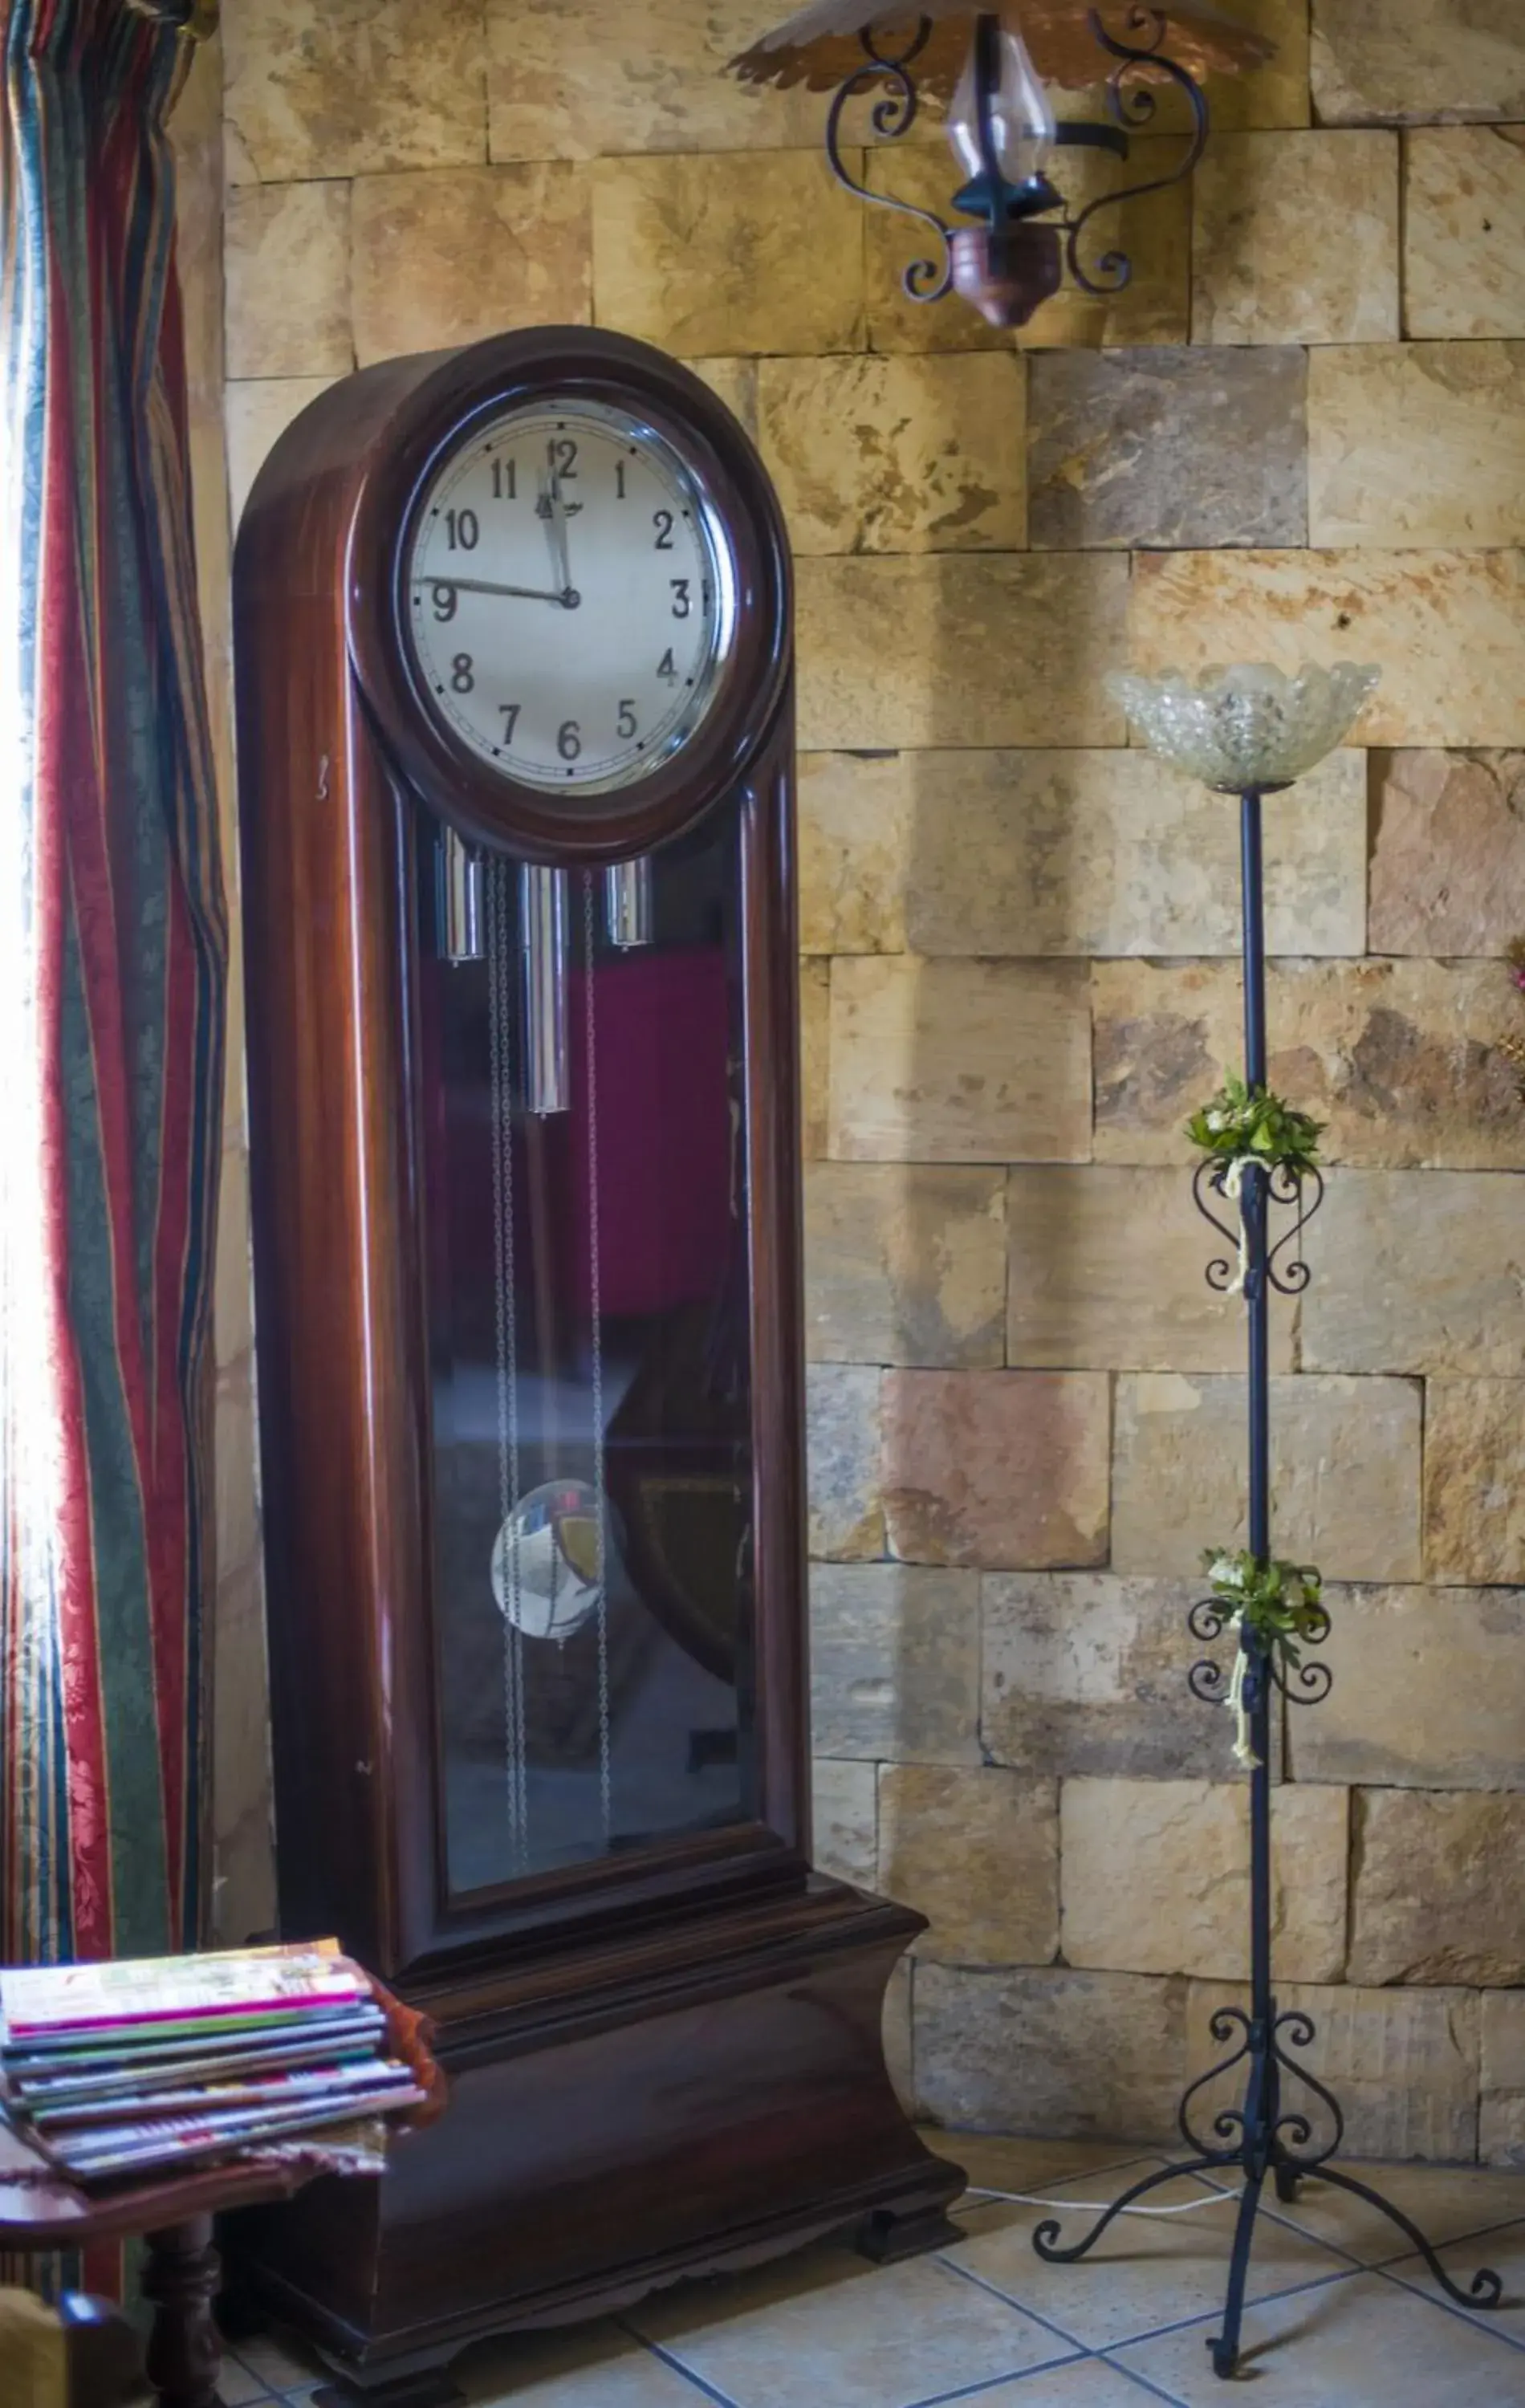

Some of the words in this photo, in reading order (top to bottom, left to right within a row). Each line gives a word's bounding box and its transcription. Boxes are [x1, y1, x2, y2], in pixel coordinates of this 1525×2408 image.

[491, 458, 516, 498] 11
[547, 437, 578, 478] 12
[615, 460, 625, 498] 1
[445, 508, 479, 551] 10
[653, 510, 673, 550] 2
[432, 581, 458, 622] 9
[670, 579, 690, 619] 3
[451, 653, 475, 694] 8
[657, 647, 678, 687] 4
[498, 703, 522, 745] 7
[616, 698, 637, 739] 5
[557, 720, 582, 761] 6
